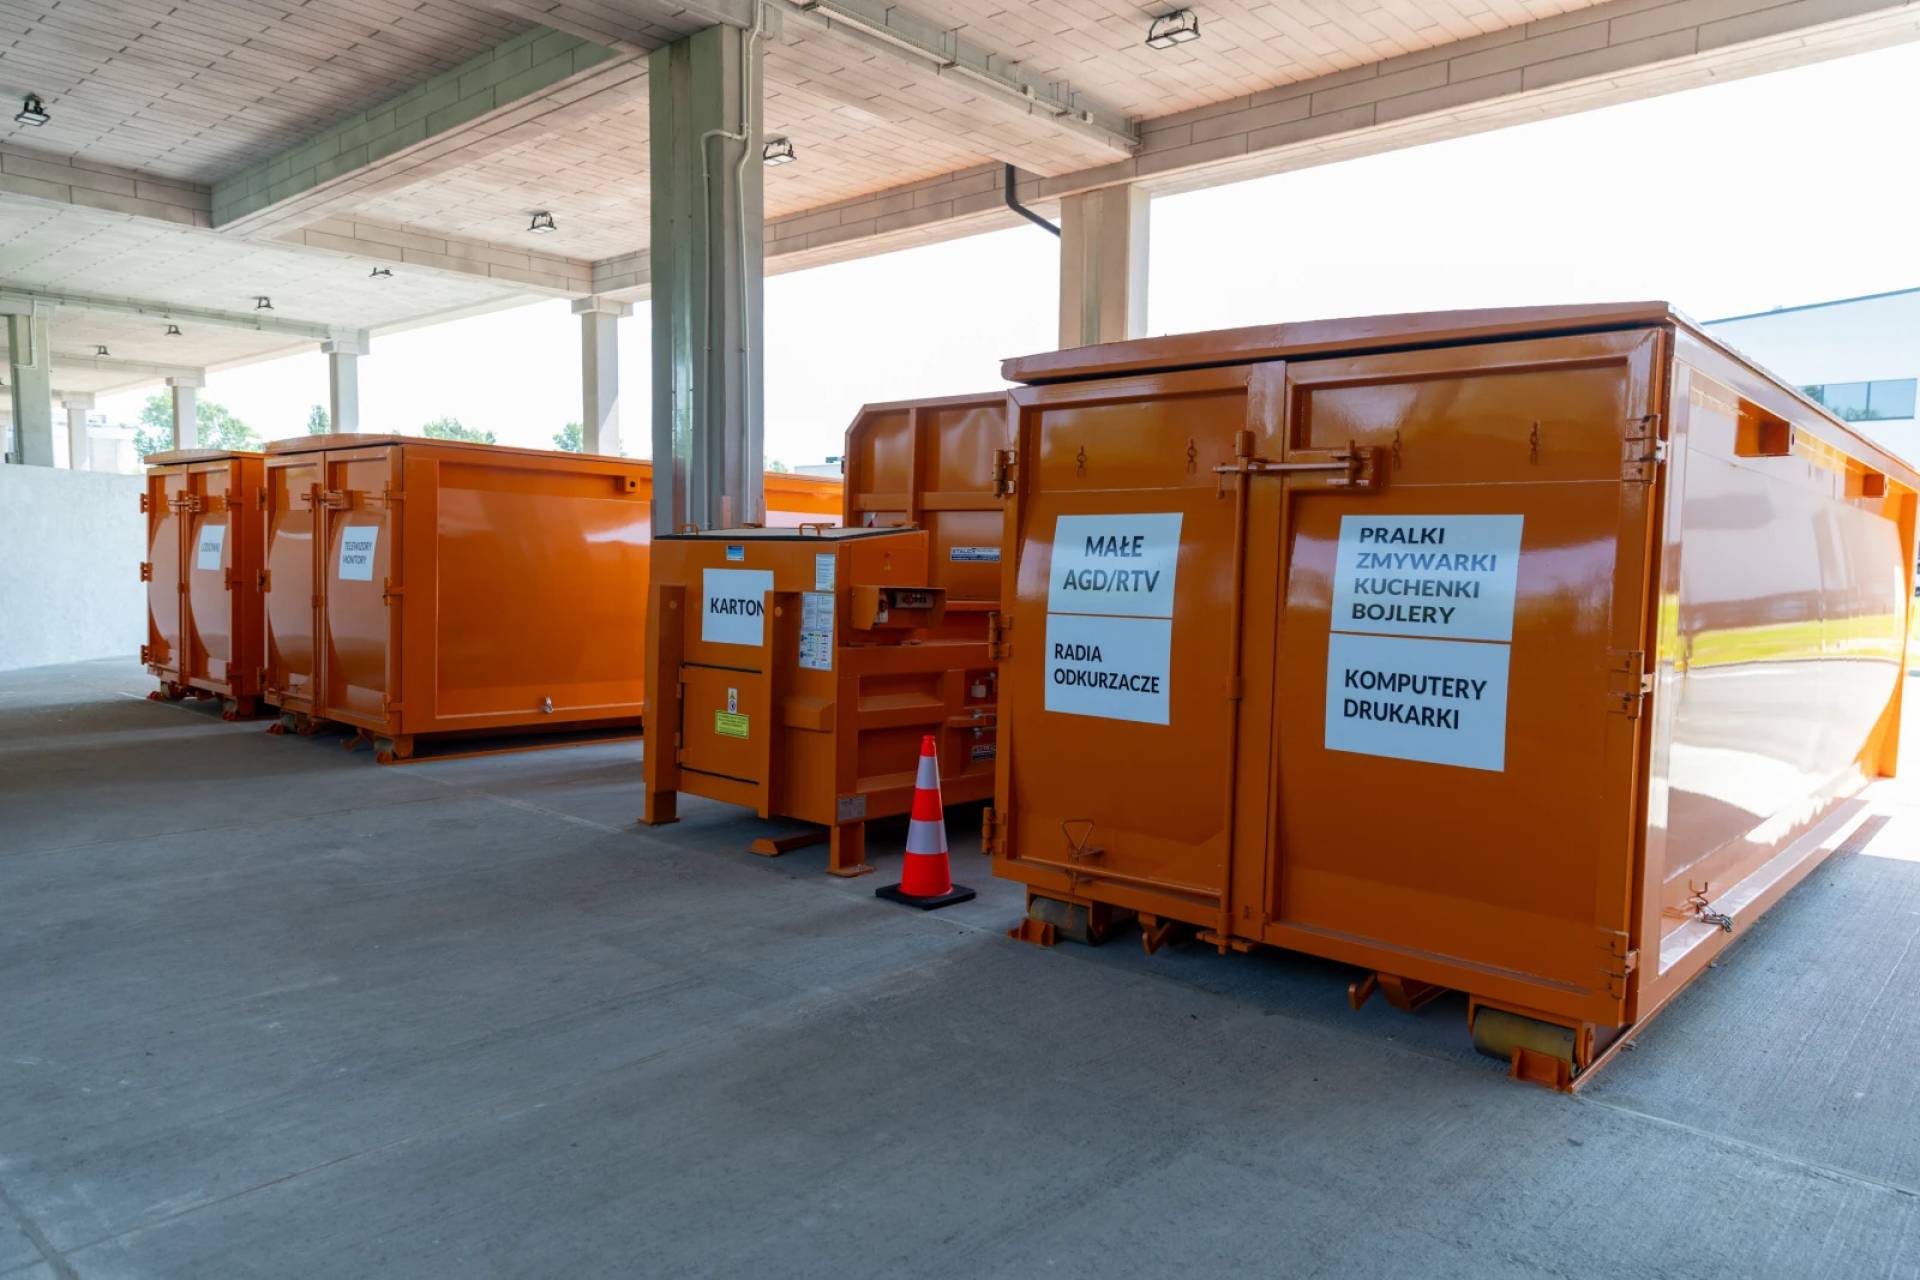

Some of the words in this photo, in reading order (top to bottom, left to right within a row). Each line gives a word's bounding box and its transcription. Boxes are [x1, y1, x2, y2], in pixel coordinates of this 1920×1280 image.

[1085, 535, 1144, 557] MAŁE
[1359, 527, 1445, 544] PRALKI
[1355, 552, 1497, 572] ZMYWARKI
[1062, 568, 1160, 592] AGD/RTV
[1354, 577, 1480, 599] KUCHENKI
[710, 597, 764, 616] KARTON
[1352, 603, 1456, 624] BOJLERY
[1054, 643, 1103, 662] RADIA
[1054, 668, 1160, 694] ODKURZACZE
[1344, 668, 1487, 700] KOMPUTERY
[1343, 697, 1460, 730] DRUKARKI
